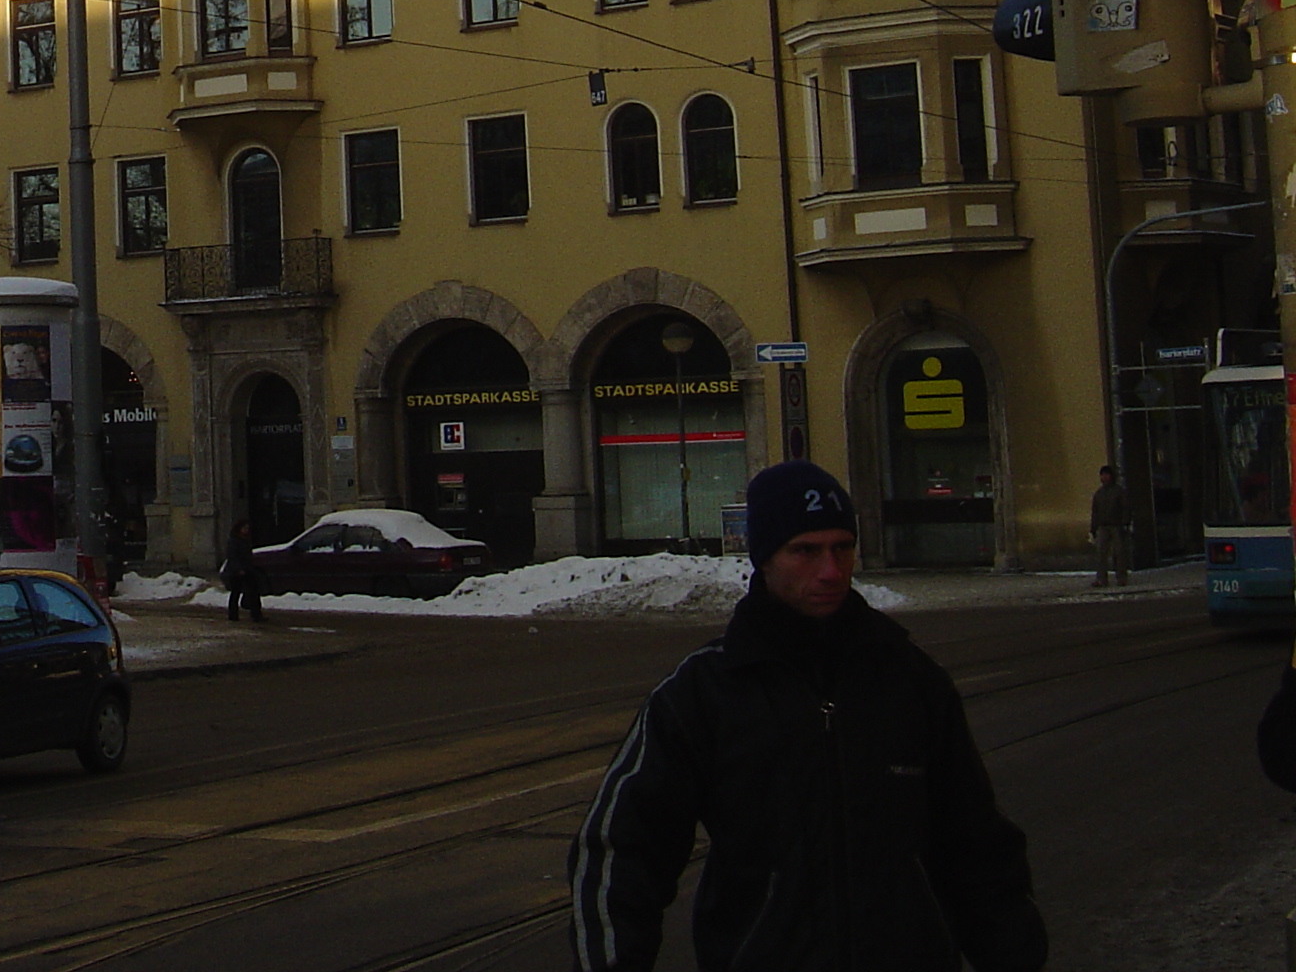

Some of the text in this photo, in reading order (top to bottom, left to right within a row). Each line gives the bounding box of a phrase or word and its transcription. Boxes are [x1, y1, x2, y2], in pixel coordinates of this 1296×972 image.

[1012, 5, 1045, 41] 322
[593, 380, 740, 399] STADTSPARKASSE
[406, 390, 541, 408] STADTSPARKASSE
[1212, 579, 1240, 594] 2140
